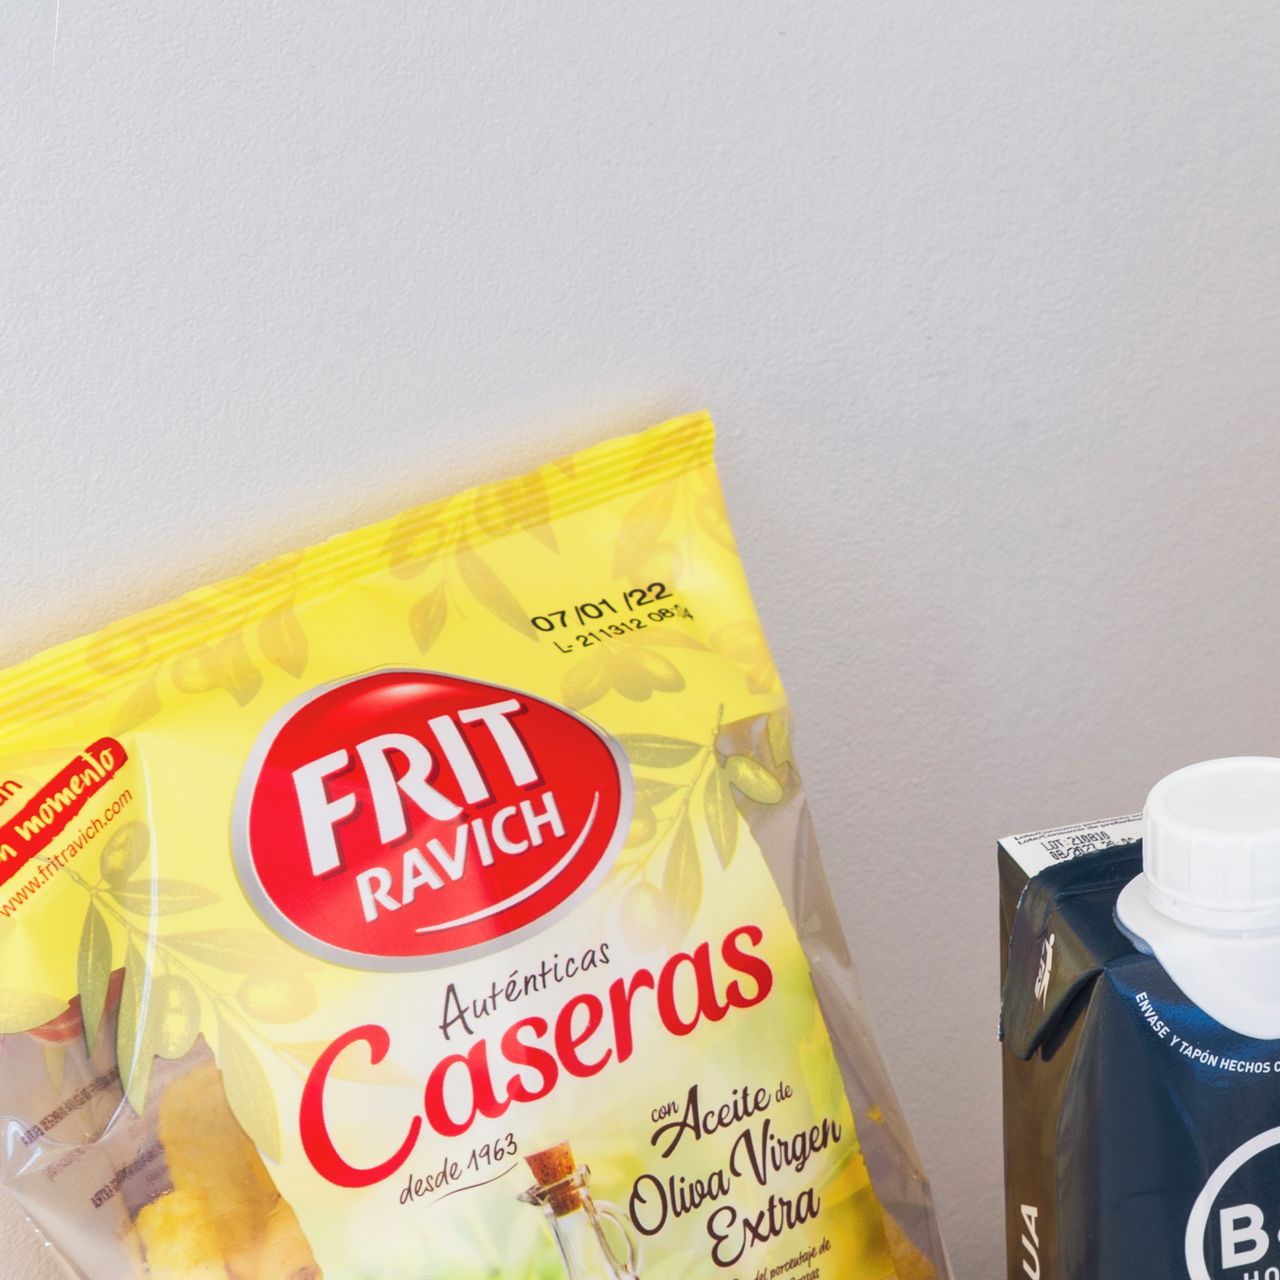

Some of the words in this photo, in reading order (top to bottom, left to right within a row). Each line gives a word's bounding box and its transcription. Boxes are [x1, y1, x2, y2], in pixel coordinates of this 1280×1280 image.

[14, 748, 115, 841] momento
[291, 698, 541, 877] FRIT
[0, 788, 133, 918] www.fritravich.com
[355, 791, 567, 923] RAVICH
[439, 943, 611, 1041] Auténticas
[1135, 992, 1170, 1038] ENVASE
[1169, 1034, 1181, 1048] Y
[1178, 1040, 1218, 1067] TAPÓN
[1220, 1057, 1271, 1074] HECHOS
[299, 925, 775, 1188] Caseras
[775, 1081, 793, 1103] de
[650, 1084, 771, 1159] Aceite
[651, 1101, 679, 1123] con
[400, 1157, 463, 1205] desde
[467, 1132, 518, 1171] 1963
[629, 1169, 731, 1236] Oliva
[729, 1117, 842, 1186] Virgen
[707, 1187, 821, 1268] Extra
[819, 1236, 831, 1254] de
